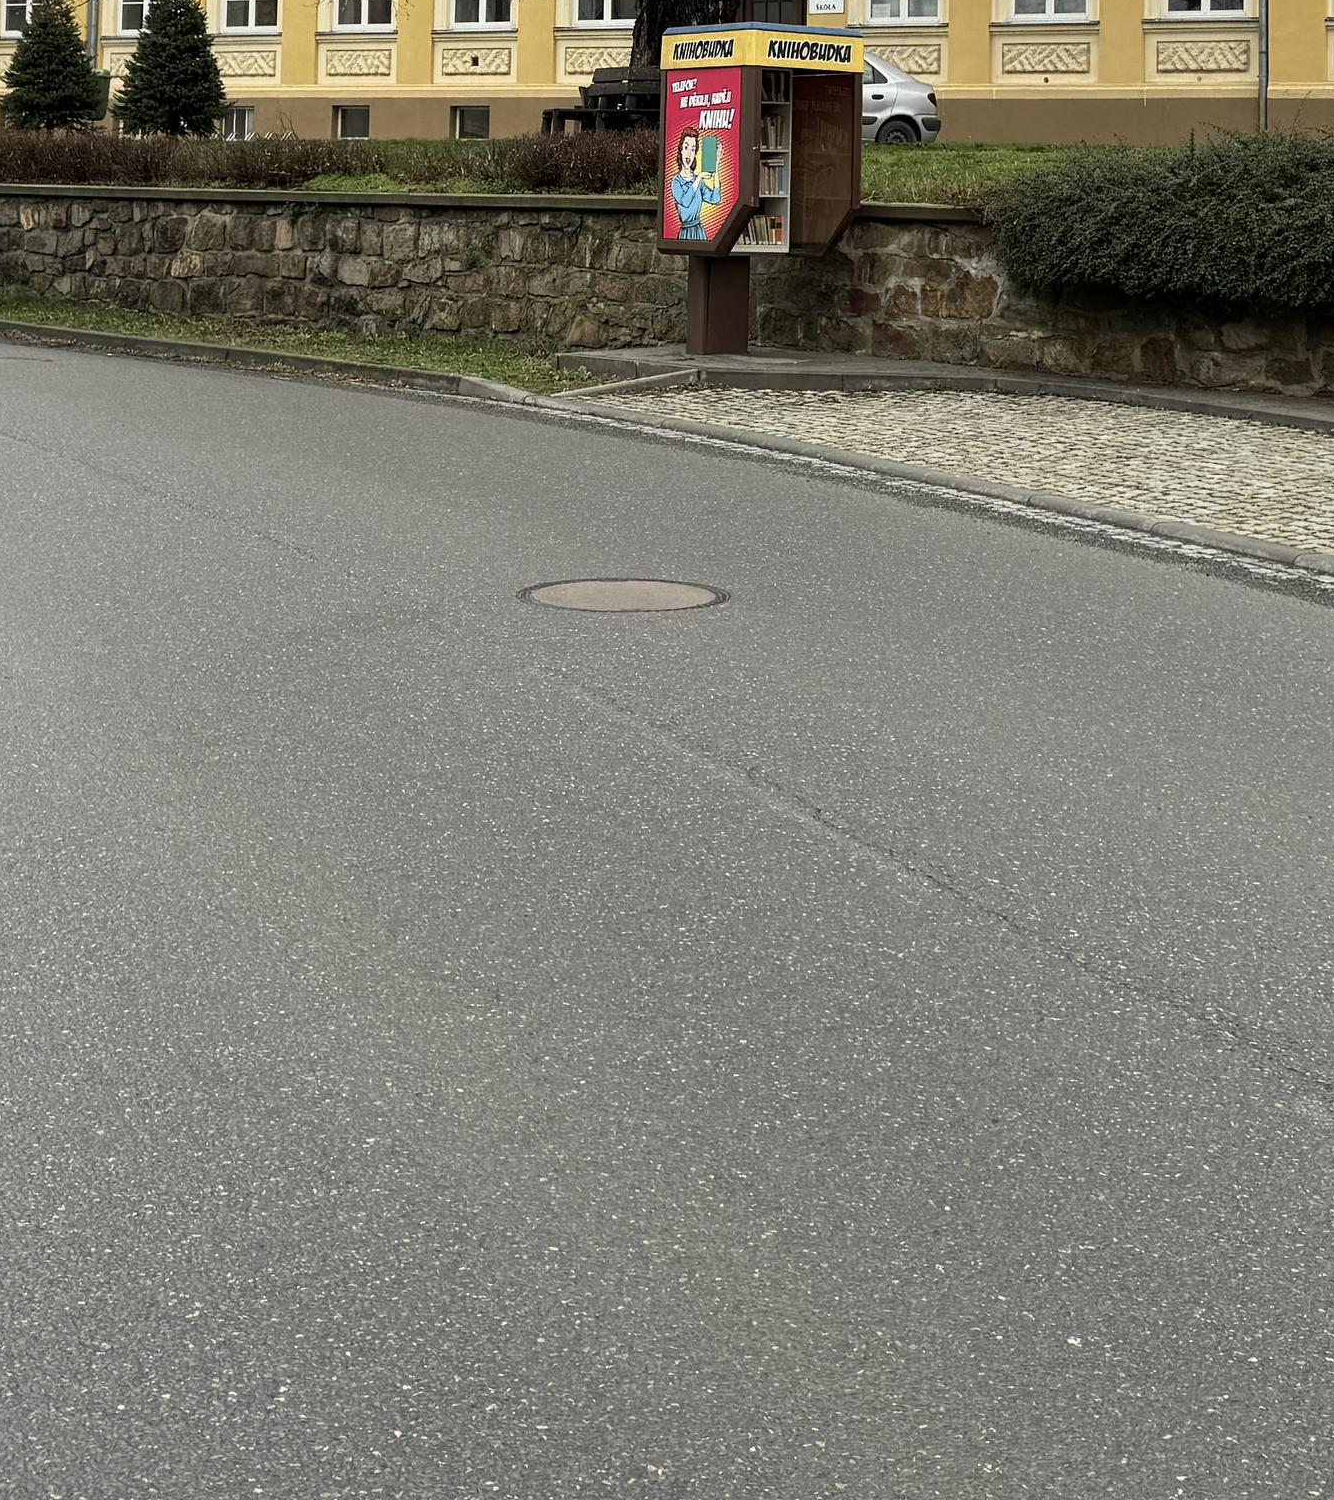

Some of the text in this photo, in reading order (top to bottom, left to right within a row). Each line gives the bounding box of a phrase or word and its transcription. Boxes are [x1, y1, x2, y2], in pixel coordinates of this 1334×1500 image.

[816, 3, 837, 11] ŠKOLA
[673, 39, 734, 61] KNIHOBUDKA
[768, 40, 852, 63] KNIHOBUDKA
[698, 108, 736, 130] KNIHU!
